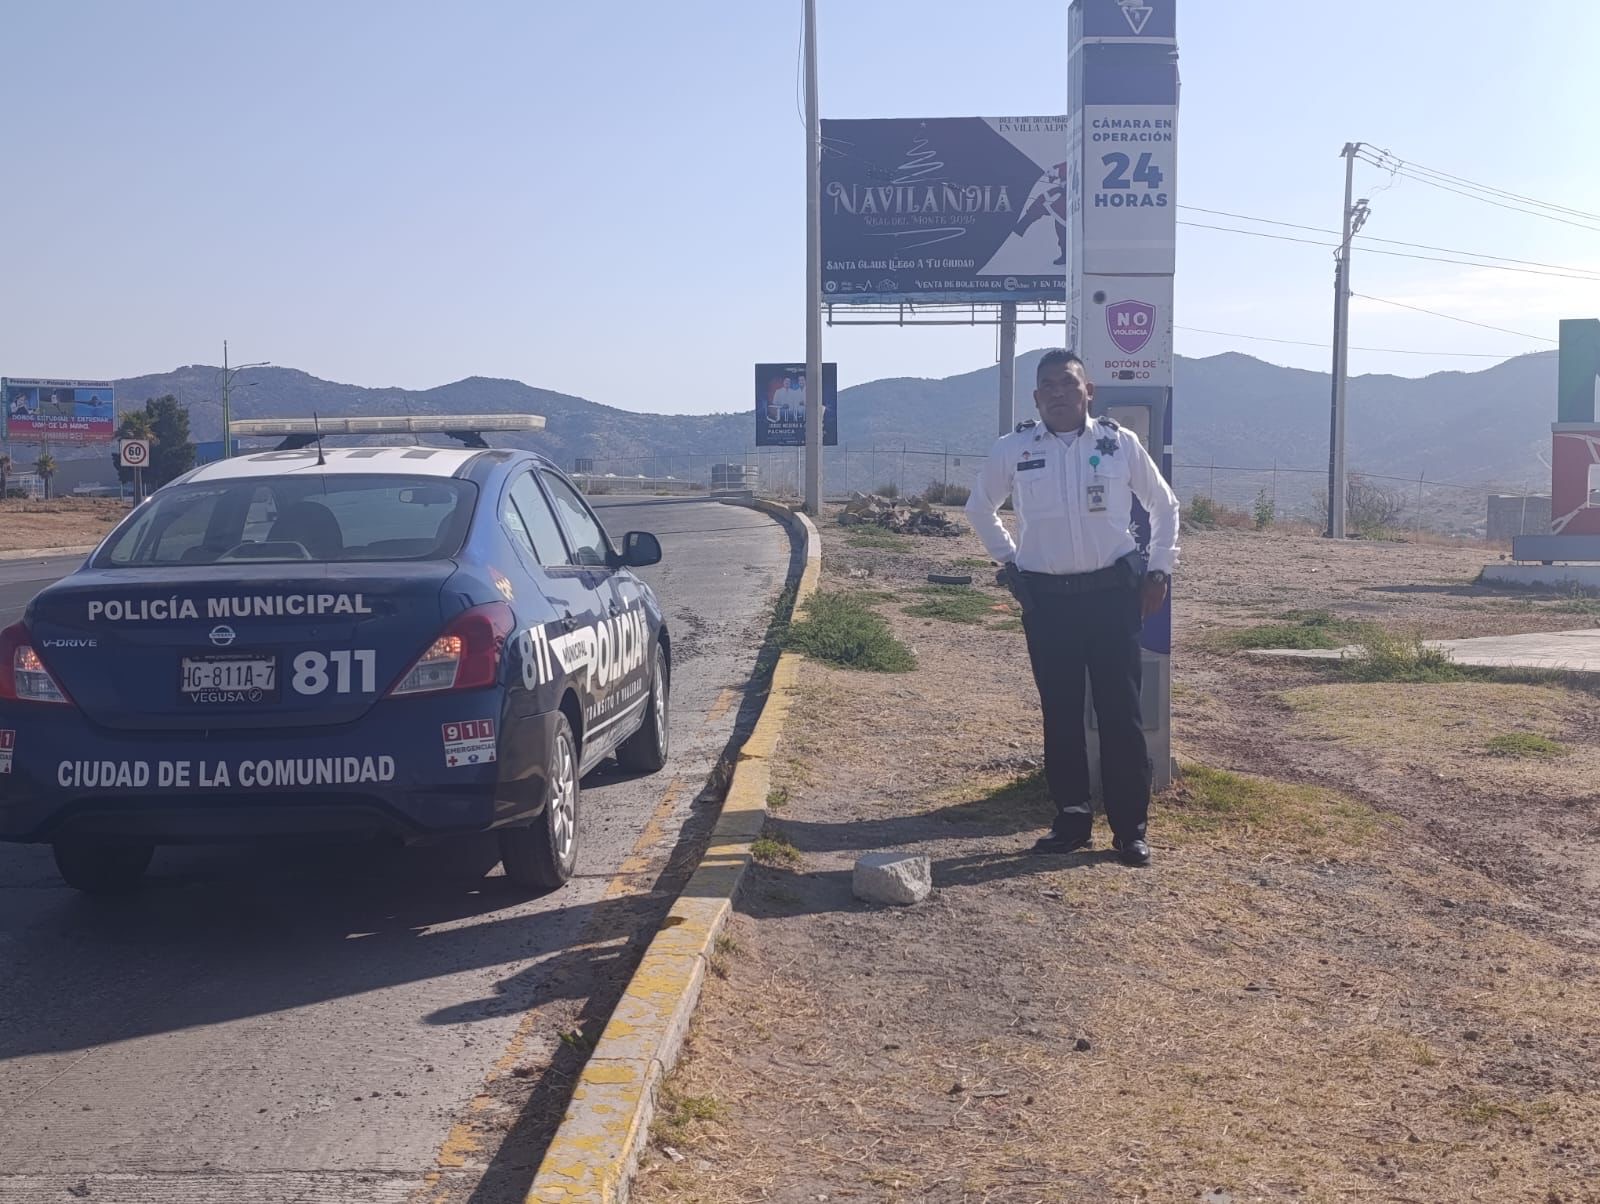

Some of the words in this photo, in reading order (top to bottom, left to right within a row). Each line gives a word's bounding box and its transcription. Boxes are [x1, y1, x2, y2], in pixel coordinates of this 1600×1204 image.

[1000, 124, 1010, 132] EN
[1014, 124, 1040, 132] VILLA
[1092, 117, 1151, 129] CÁMARA
[1155, 119, 1172, 129] EN
[1092, 131, 1172, 142] OPERACIÓN
[1101, 152, 1163, 189] 24
[1094, 193, 1168, 207] HORAS
[826, 260, 856, 270] SANTA
[917, 259, 924, 269] A
[926, 258, 941, 269] TU
[915, 280, 943, 289] VENTA
[944, 280, 955, 288] DE
[991, 280, 1002, 288] EN
[1117, 312, 1148, 326] NO
[1104, 359, 1140, 368] BOTÓN
[1142, 360, 1157, 368] DE
[128, 446, 141, 456] 60
[88, 595, 199, 621] POLICÍA
[207, 594, 372, 618] MUNICIPAL
[42, 639, 97, 648] V-DRIVE
[519, 624, 554, 690] 811
[183, 665, 274, 688] HG-811A-7
[292, 650, 376, 695] 811
[191, 691, 245, 703] VEGUSA
[447, 722, 490, 740] 911
[57, 760, 150, 787] CIUDAD
[158, 760, 191, 787] DE
[199, 760, 232, 787] LA
[238, 755, 395, 787] COMUNIDAD
